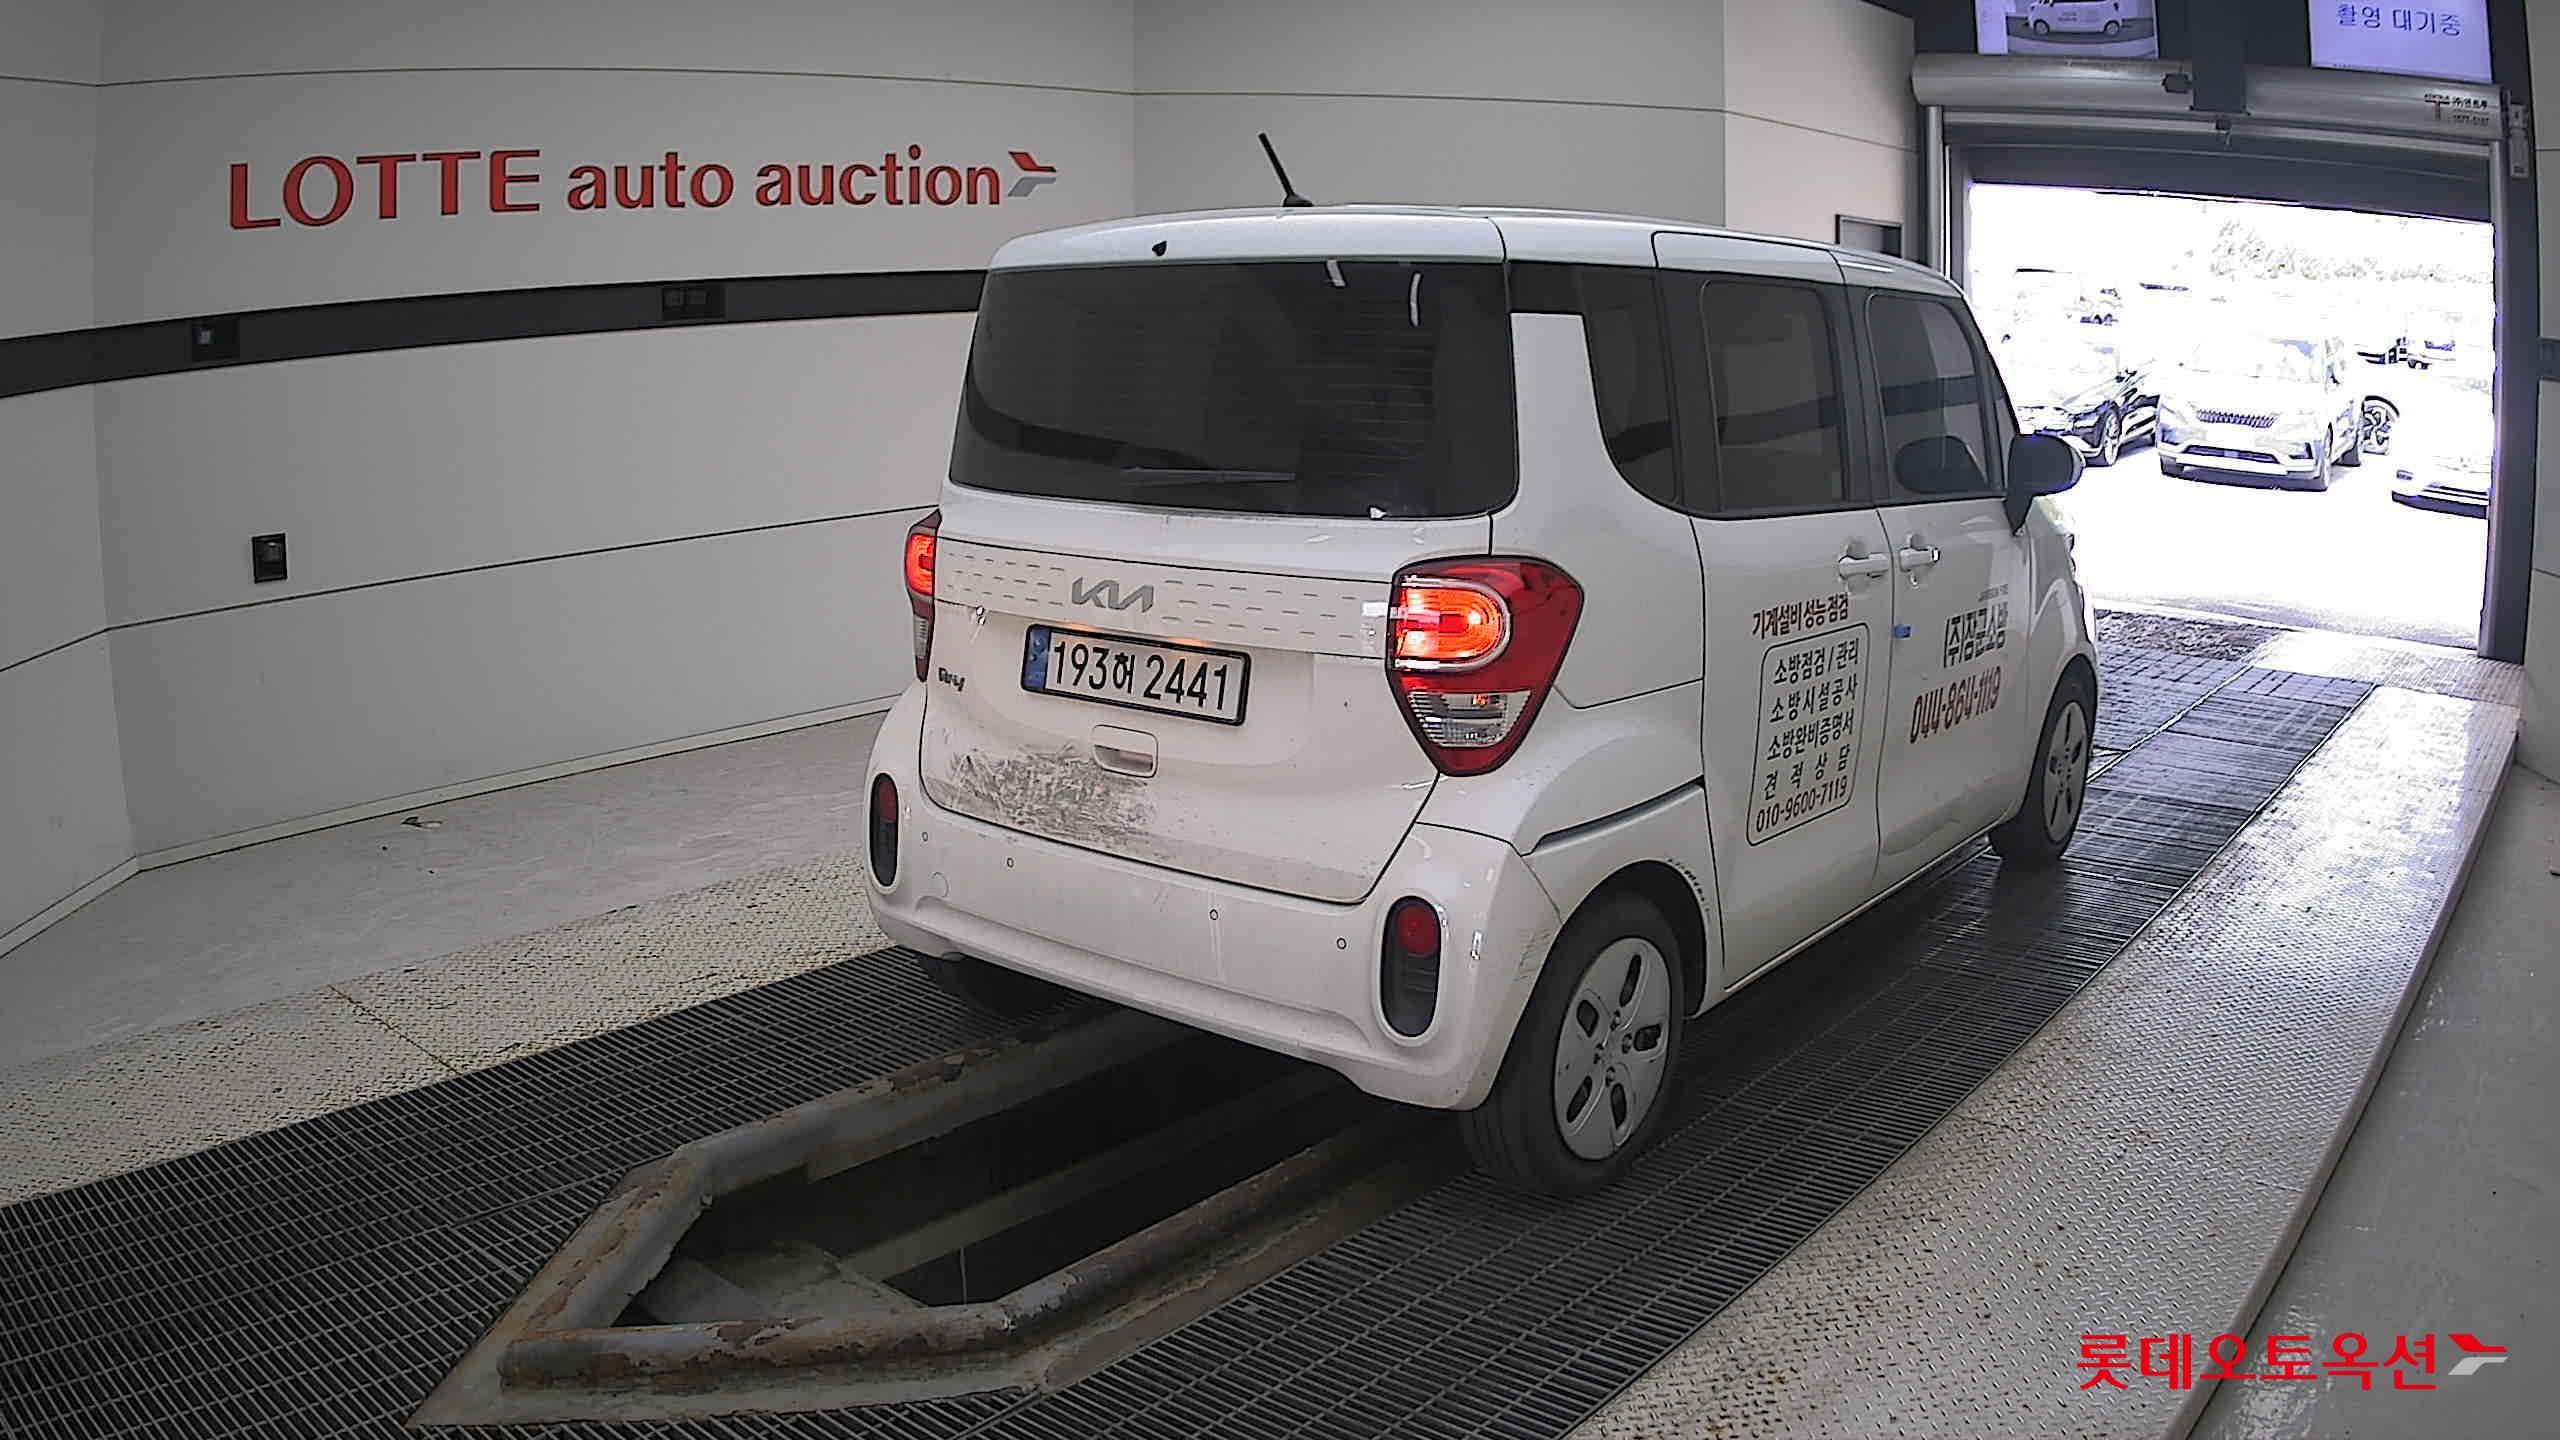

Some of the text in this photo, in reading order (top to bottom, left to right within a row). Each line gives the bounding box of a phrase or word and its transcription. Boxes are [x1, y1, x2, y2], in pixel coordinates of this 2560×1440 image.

[2338, 3, 2461, 37] 촬영 대기중
[229, 144, 1001, 230] LOTTE auto auction
[1054, 640, 1229, 711] 193허 2441
[1769, 673, 1859, 723] 소방시설공사
[1909, 665, 2001, 745] 044-864-1119
[1766, 707, 1855, 761] 소방완비증명서
[1756, 774, 1848, 833] 010-9600-7119
